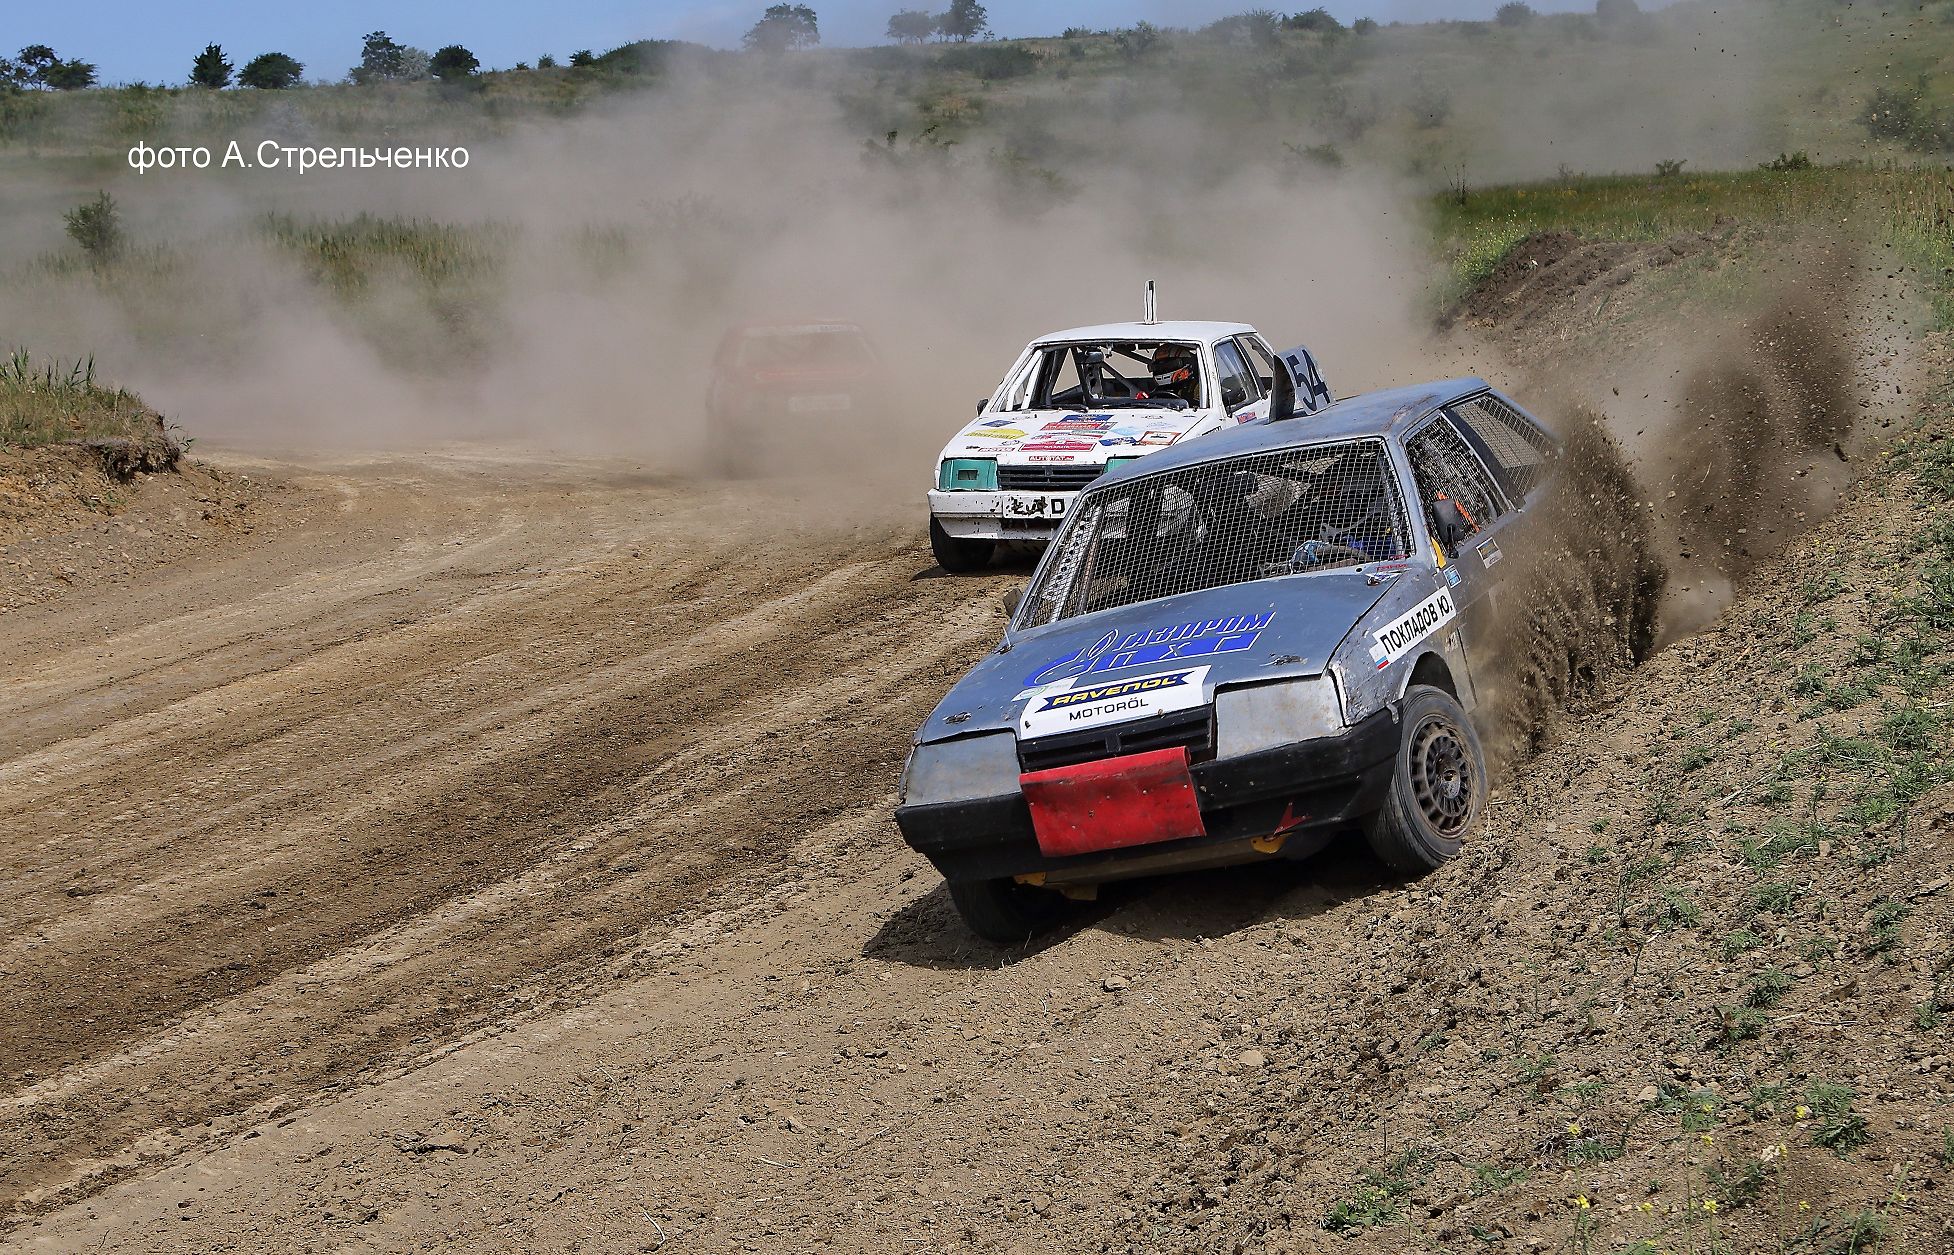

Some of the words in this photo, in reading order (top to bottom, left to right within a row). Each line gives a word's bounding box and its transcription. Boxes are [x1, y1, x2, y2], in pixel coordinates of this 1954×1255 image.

[1286, 349, 1331, 411] 54
[1379, 602, 1439, 655] ПОКЛАДОВ
[1436, 595, 1454, 618] Ю.
[1051, 676, 1178, 707] RAVENOL
[1069, 697, 1149, 722] MOTORÖL
